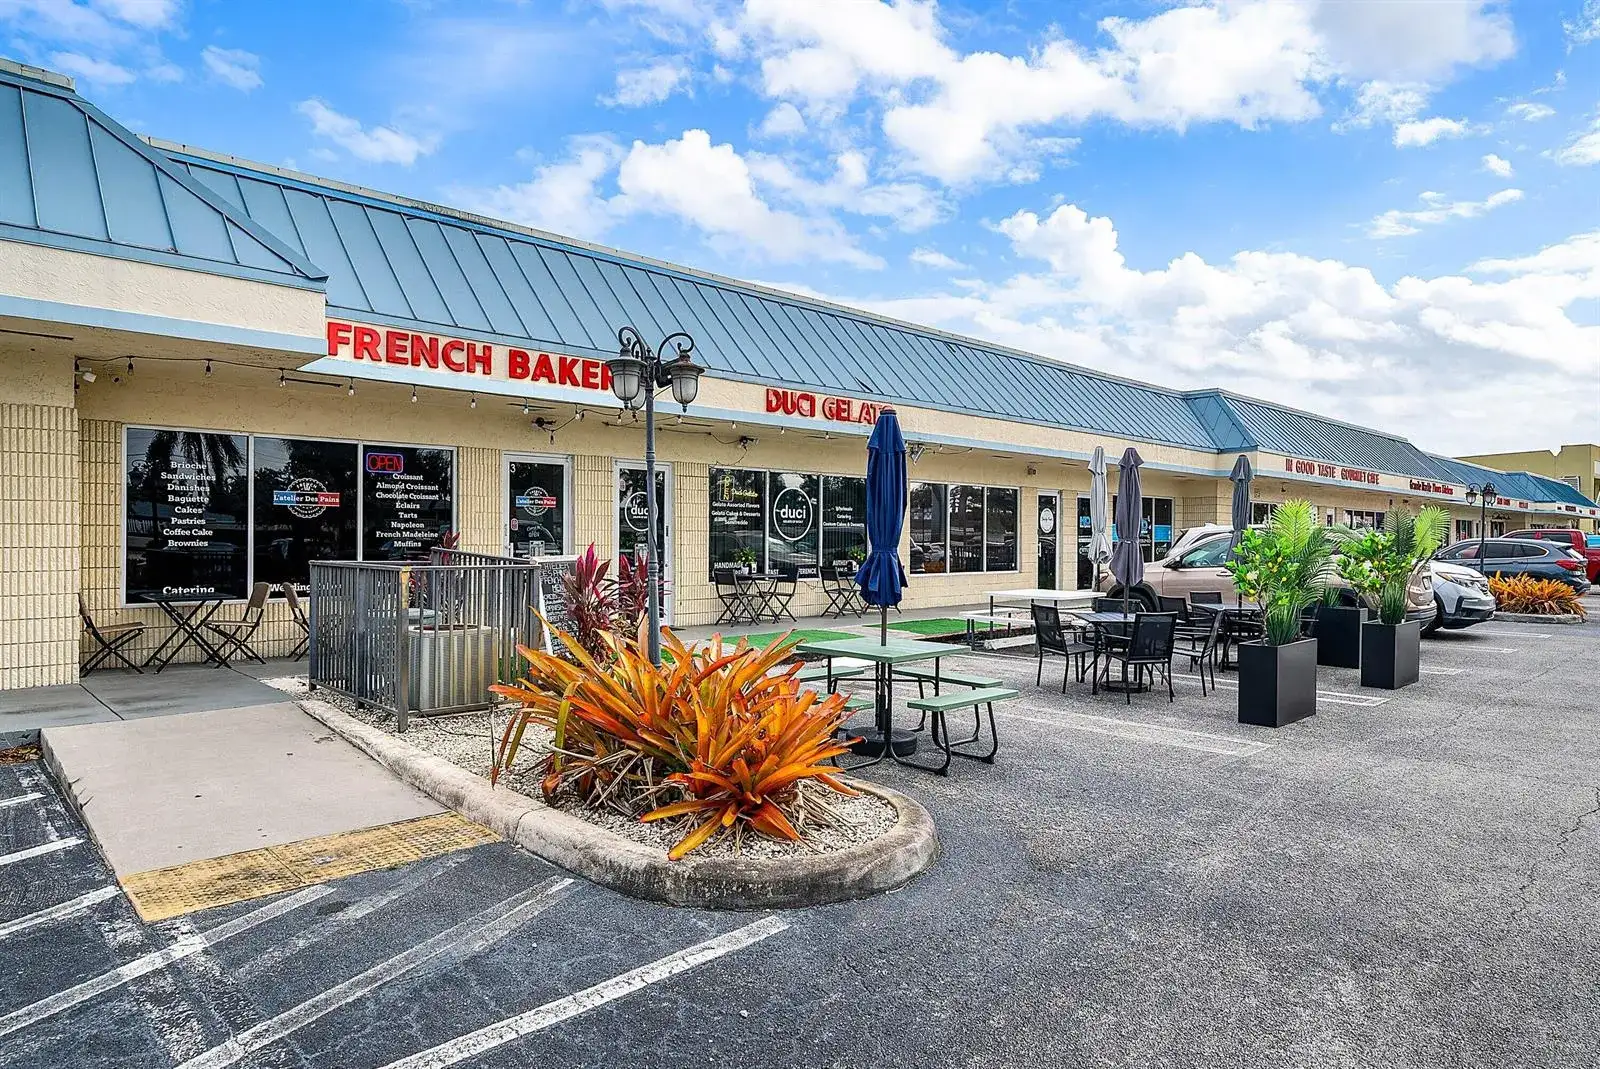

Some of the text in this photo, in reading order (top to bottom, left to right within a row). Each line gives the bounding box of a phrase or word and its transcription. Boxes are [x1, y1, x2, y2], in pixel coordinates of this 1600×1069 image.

[327, 321, 614, 391] FRENCH BAKER
[766, 388, 893, 424] DUCI GELAT
[170, 461, 207, 470] Brioche
[368, 455, 401, 471] OPEN
[510, 463, 516, 473] 3
[1295, 460, 1315, 475] GOOD
[1317, 463, 1336, 479] TASTE
[160, 471, 216, 481] Sandwiches
[392, 473, 424, 481] Croissant
[658, 473, 663, 481] 4
[167, 483, 210, 492] Danishes
[406, 483, 439, 491] Croissant
[167, 494, 210, 504] Baguette
[320, 495, 340, 503] Pains
[375, 492, 408, 500] Chocolate
[174, 506, 203, 514] Cakes
[631, 504, 649, 515] duc
[780, 504, 807, 519] duci
[170, 517, 206, 525] Pastries
[391, 521, 425, 530] Napoleon
[163, 528, 214, 536] Coffee Cake
[167, 539, 209, 547] Brownies
[393, 540, 422, 548] Muffins
